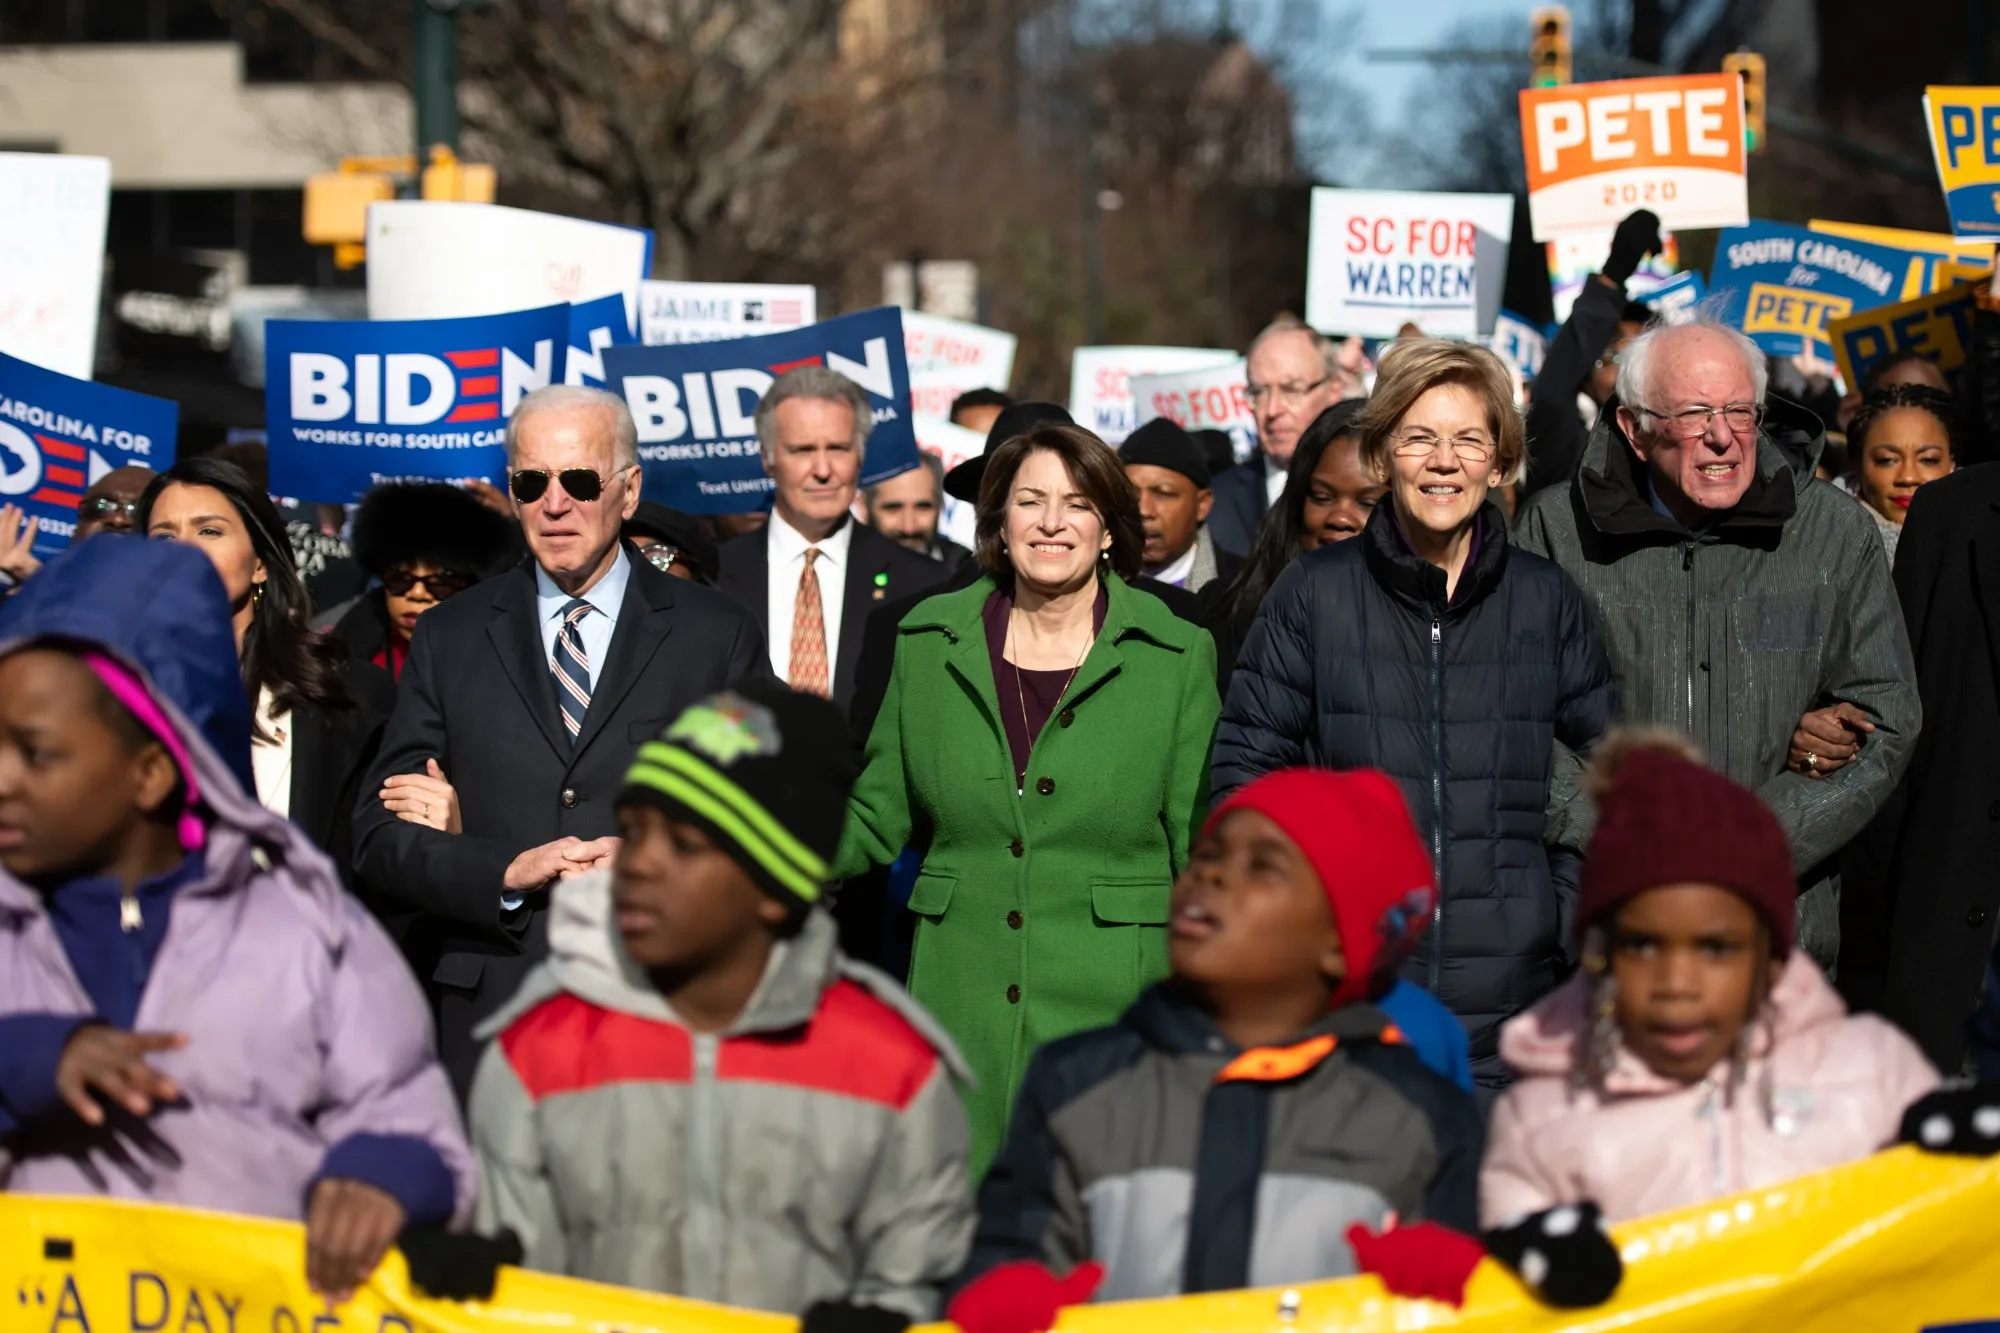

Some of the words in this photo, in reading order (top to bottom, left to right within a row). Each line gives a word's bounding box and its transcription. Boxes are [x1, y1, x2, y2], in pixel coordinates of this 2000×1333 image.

[1535, 88, 1729, 173] PETE
[1604, 180, 1677, 206] 2020
[1345, 216, 1395, 255] SC
[1408, 219, 1475, 257] FOR
[1345, 260, 1475, 299] WARREN
[1727, 237, 1795, 269] SOUTH
[1797, 239, 1893, 296] CAROLINA
[1785, 264, 1820, 287] for
[648, 297, 734, 322] JAIME
[1843, 296, 1976, 390] PET
[290, 339, 553, 426] BIDEN
[622, 336, 895, 443] BIDN
[0, 392, 99, 444] AROLINA
[101, 426, 151, 456] FOR
[292, 426, 362, 447] WORKS
[364, 430, 402, 448] FOR
[404, 430, 470, 449] SOUTH
[637, 442, 704, 461] WORKS
[705, 441, 742, 458] FOR
[697, 480, 731, 495] Text
[129, 1270, 243, 1333] DAY
